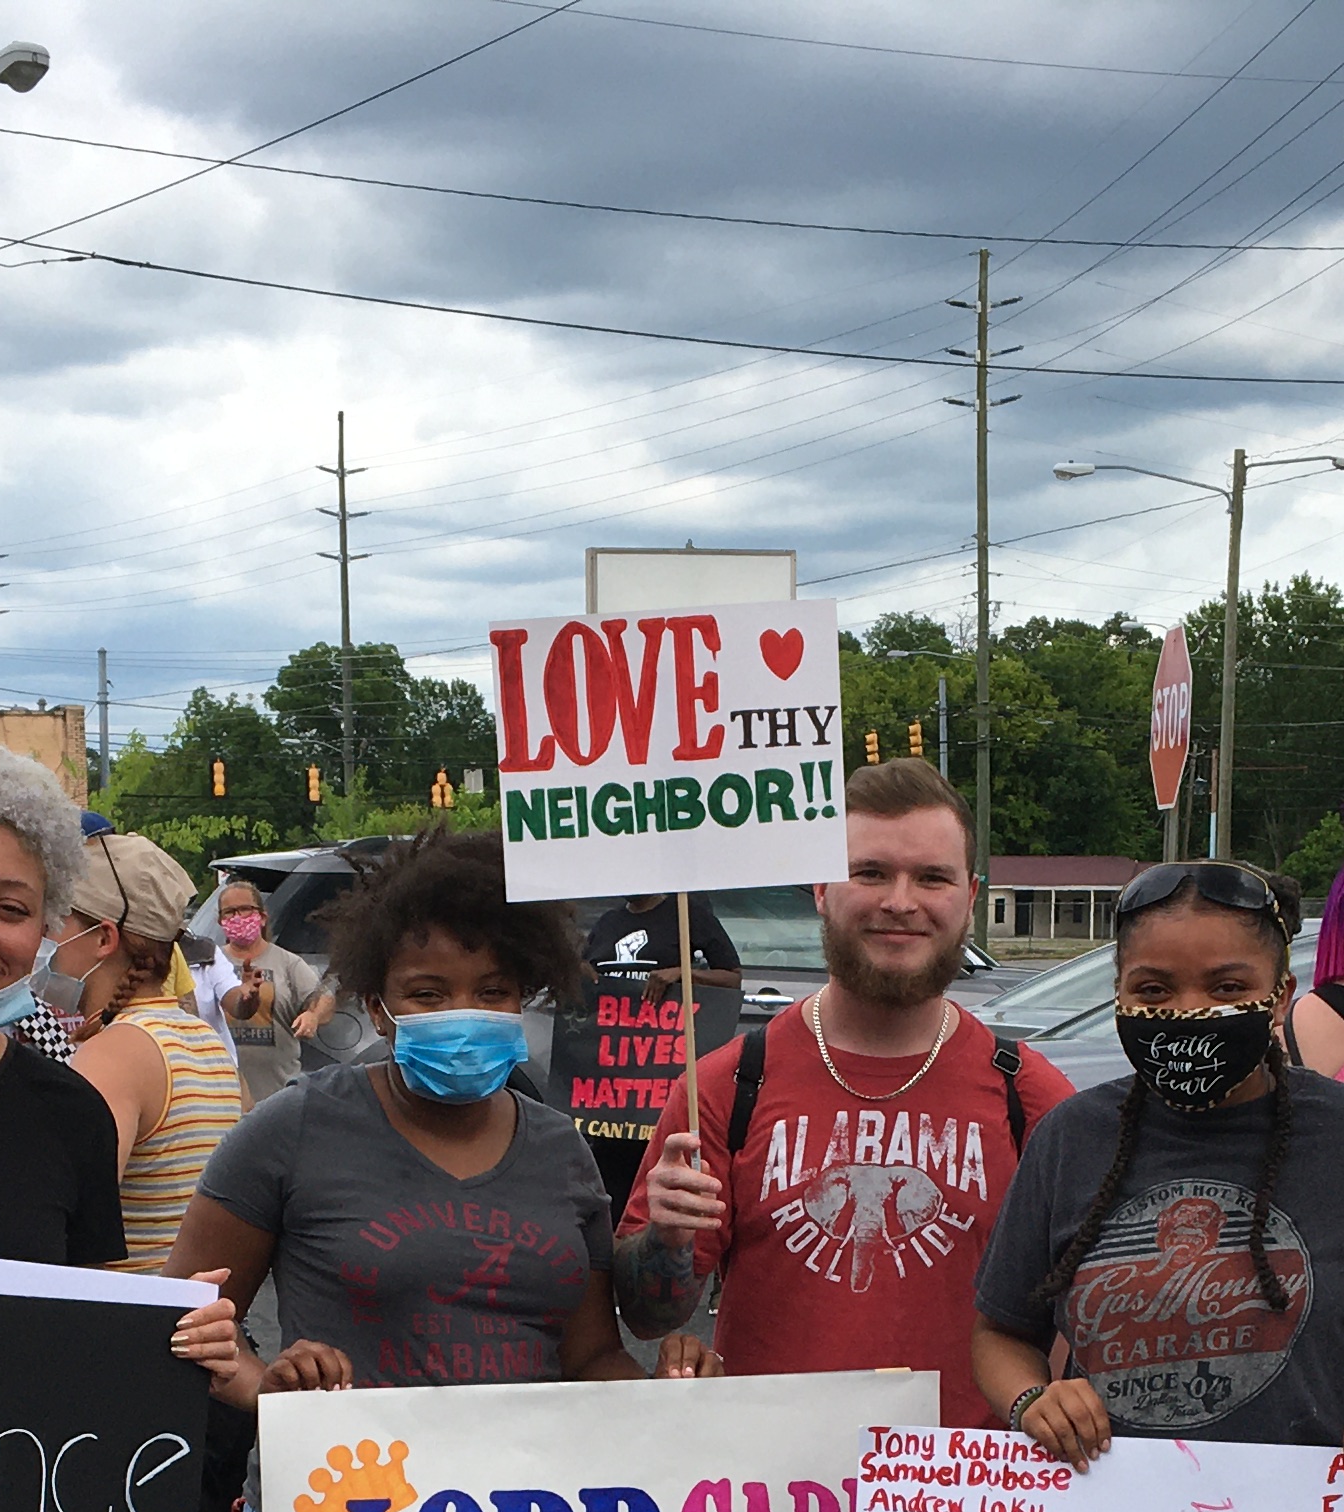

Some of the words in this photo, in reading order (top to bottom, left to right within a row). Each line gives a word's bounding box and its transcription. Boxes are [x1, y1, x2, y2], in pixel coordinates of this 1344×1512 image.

[489, 614, 725, 773] LOVE
[729, 705, 838, 750] THY
[1153, 682, 1188, 752] STOP
[505, 760, 839, 843] NEIGHBOR!!
[598, 1035, 687, 1067] LIVES
[588, 1120, 636, 1139] CAN'T
[759, 1110, 987, 1202] ALABAMA
[1117, 1184, 1184, 1222] CUSTOM
[1193, 1185, 1231, 1199] HOT
[1236, 1194, 1280, 1226] RS
[359, 1201, 585, 1286] UNIVERSITY
[771, 1199, 842, 1283] ROLL
[883, 1202, 976, 1279] TIDE
[1074, 1264, 1151, 1345] Gas
[378, 1338, 545, 1379] ALABAMA
[1102, 1324, 1256, 1366] GARAGE
[1106, 1373, 1179, 1399] SINCE
[868, 1426, 935, 1462] Tony
[949, 1430, 1059, 1464] Robins
[966, 1461, 1072, 1491] Dubose
